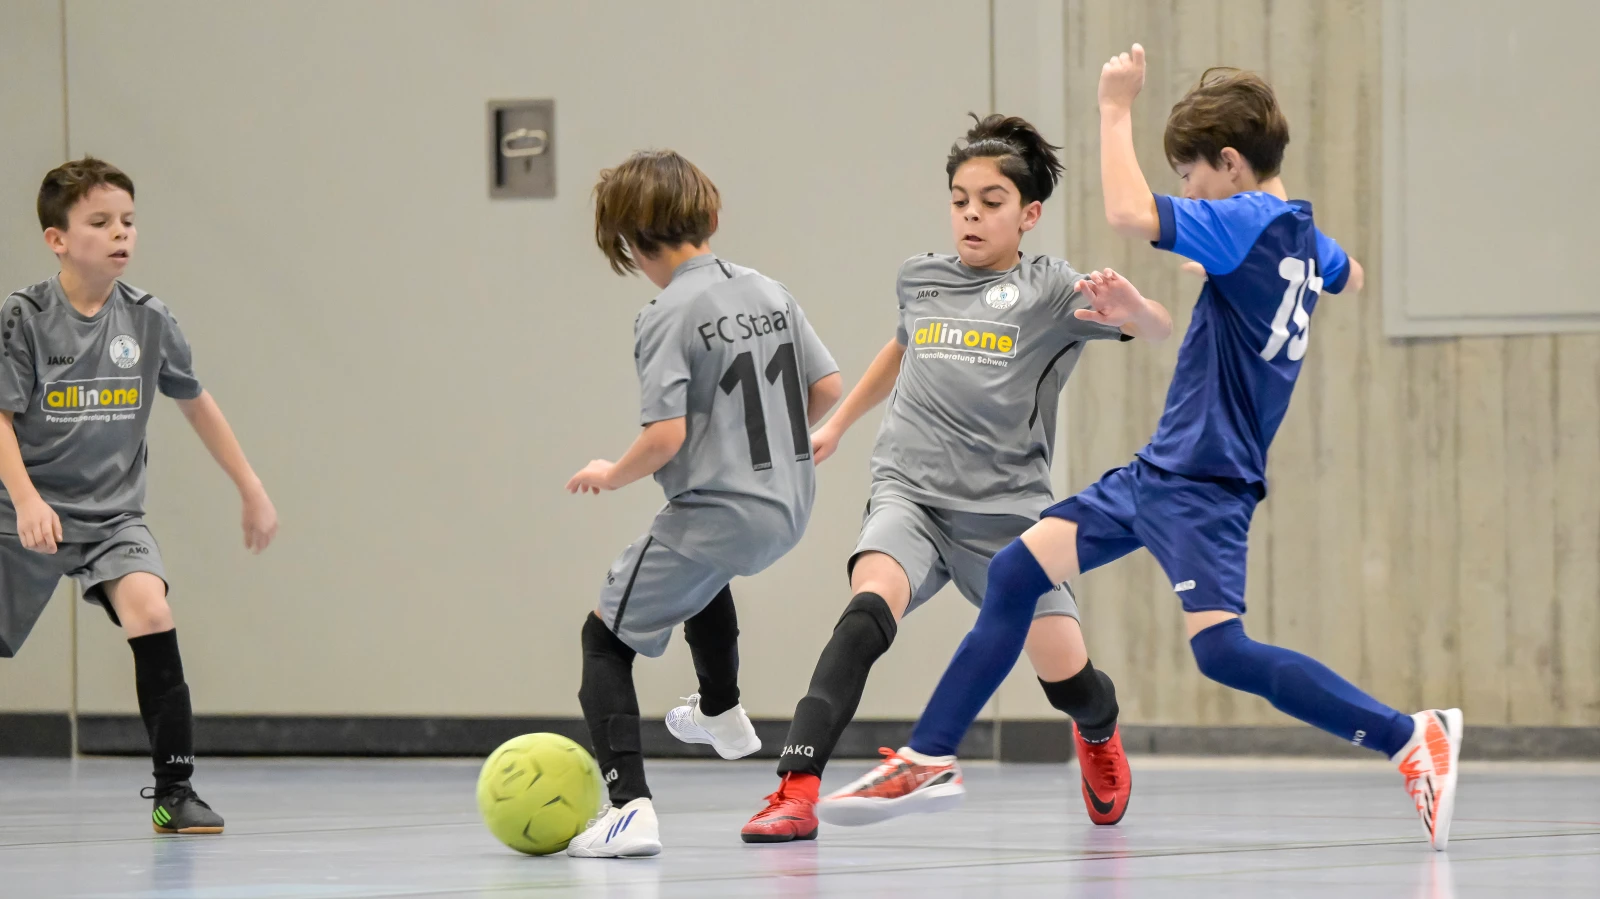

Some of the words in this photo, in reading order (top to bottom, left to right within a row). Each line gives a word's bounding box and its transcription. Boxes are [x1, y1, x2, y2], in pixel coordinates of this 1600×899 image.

[916, 290, 939, 300] JAKO
[1259, 256, 1324, 361] 15
[697, 316, 735, 351] FC
[914, 322, 1013, 353] allinone
[47, 356, 75, 366] JAKO
[916, 351, 976, 363] rsonalberatung
[977, 355, 1009, 367] Schweiz
[46, 386, 139, 408] allinone
[718, 342, 811, 472] 11
[46, 413, 111, 423] Personaberatung
[127, 545, 149, 555] AKO
[780, 744, 815, 758] JAKO
